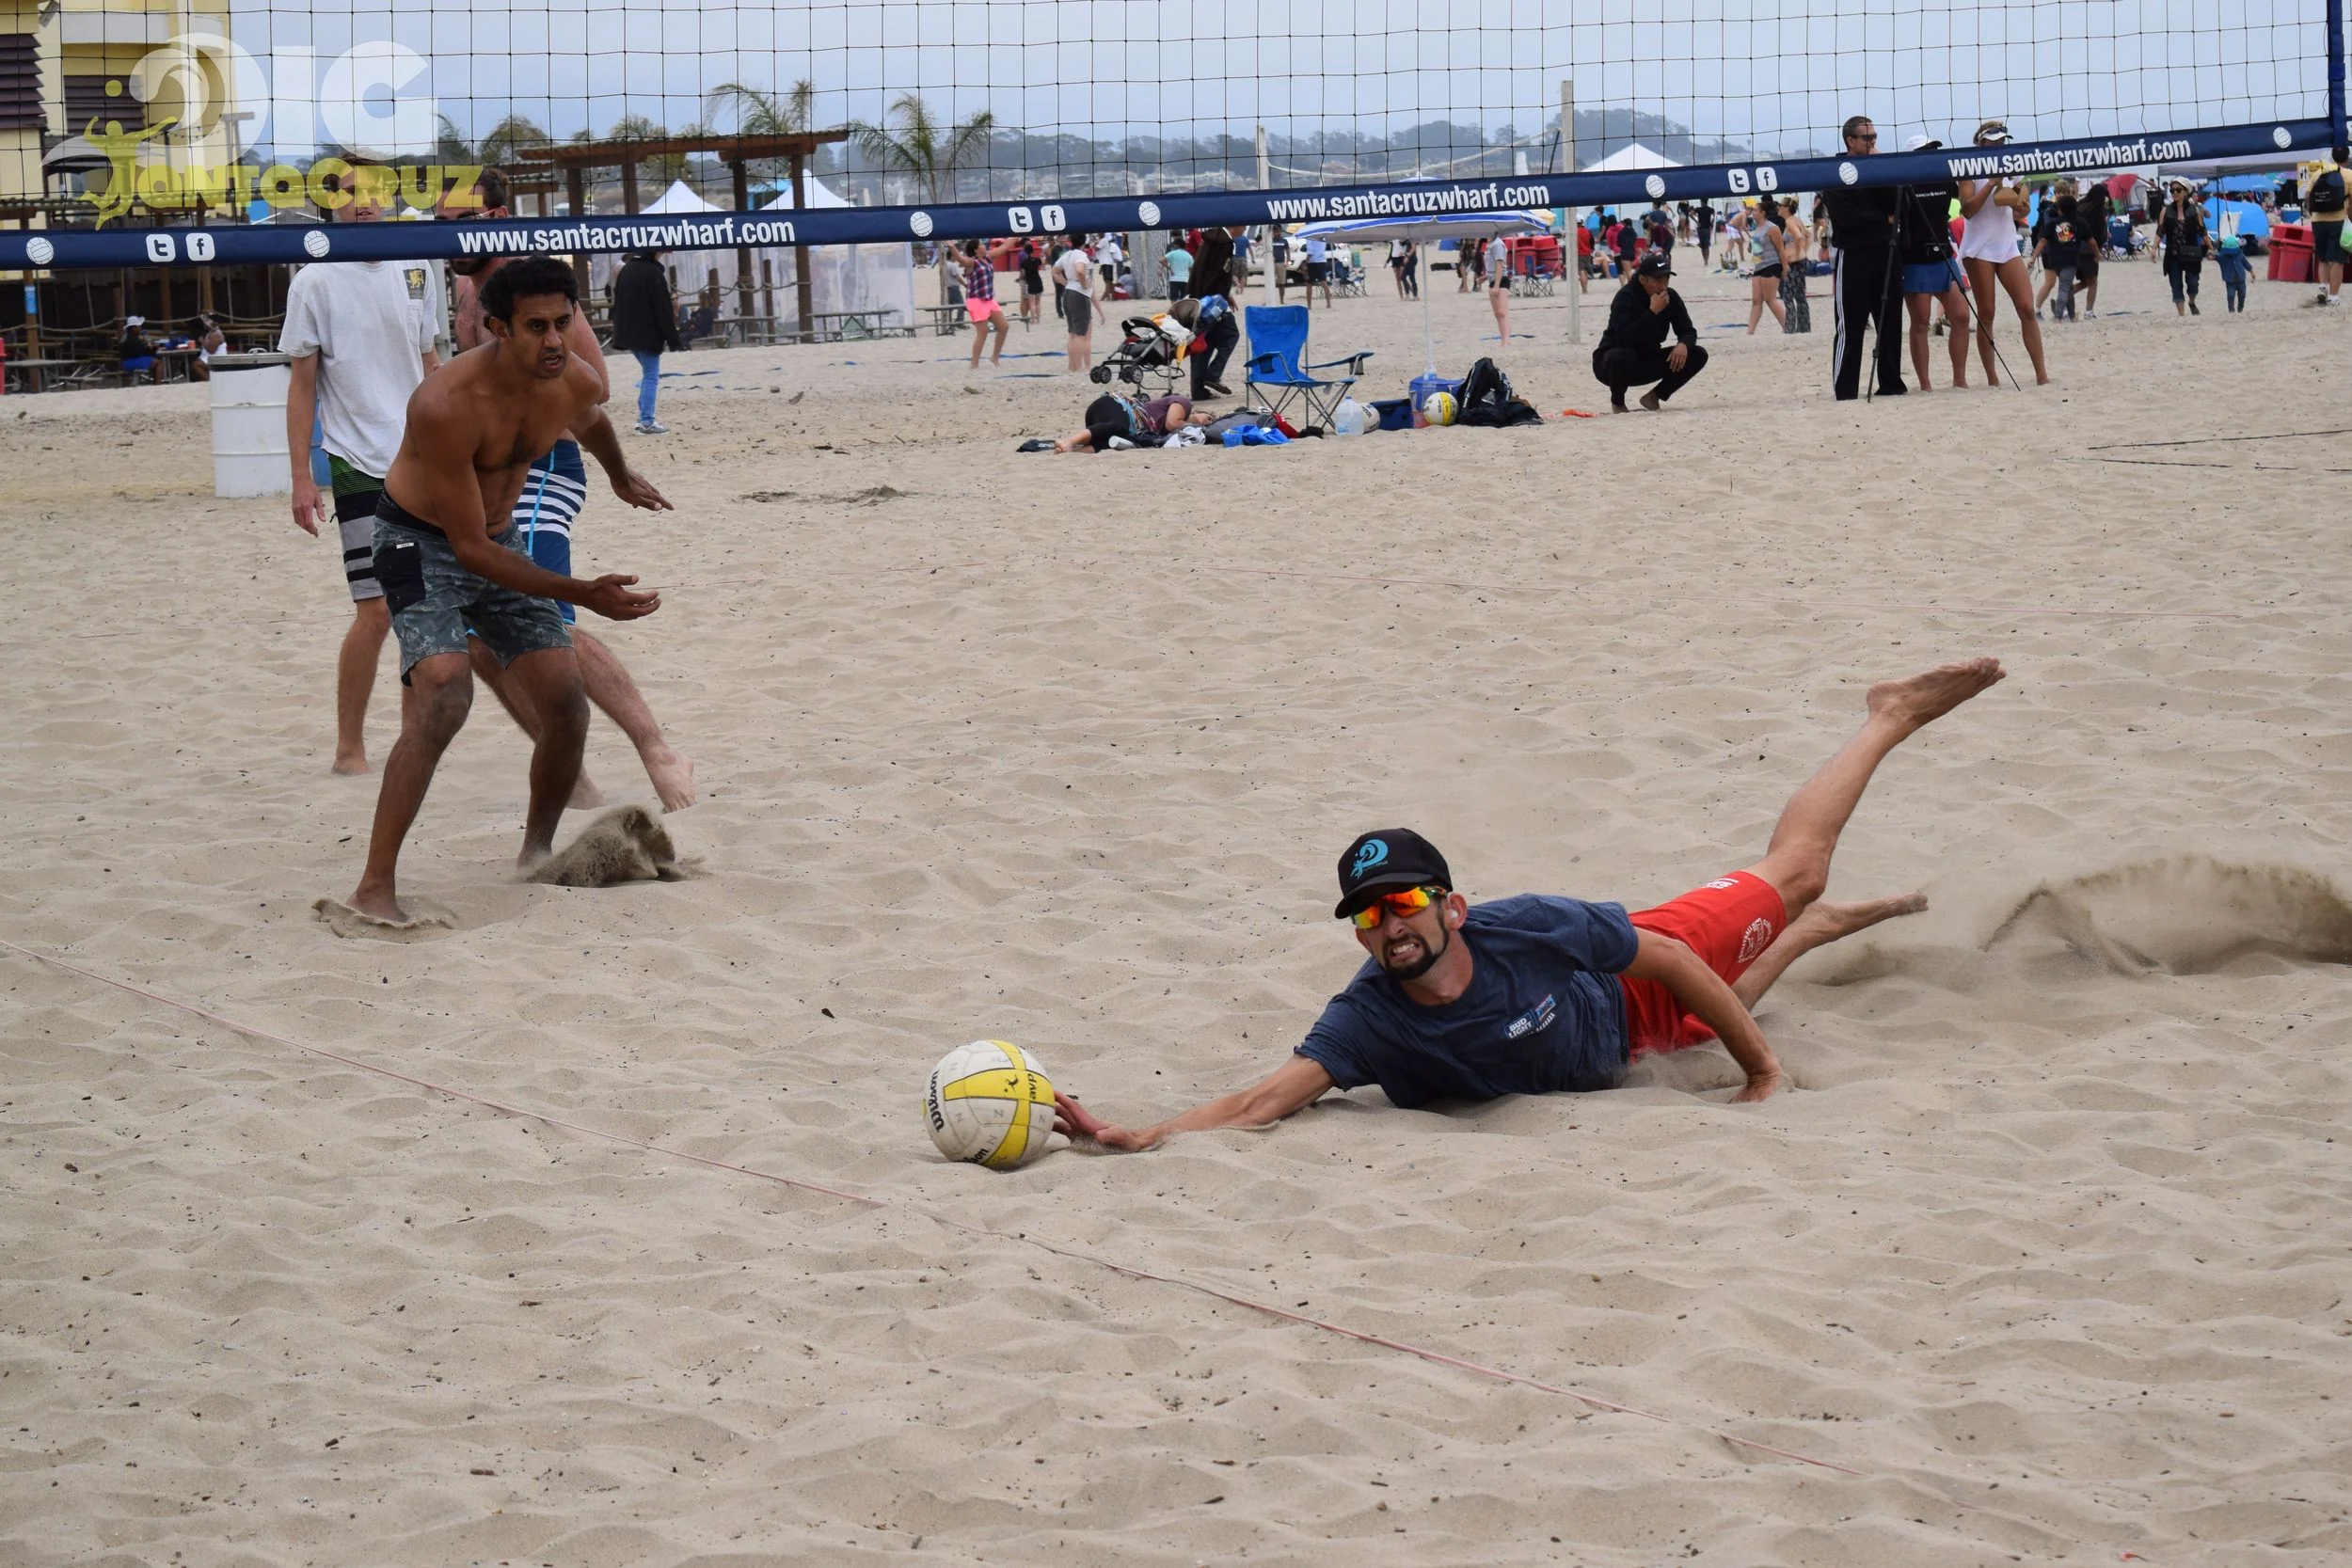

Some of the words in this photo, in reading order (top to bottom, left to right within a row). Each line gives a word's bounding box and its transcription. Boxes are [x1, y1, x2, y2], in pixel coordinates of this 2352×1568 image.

[1948, 139, 2191, 177] www.santacruzwharf.com
[1267, 182, 1549, 220] www.santacruzwharf.com
[457, 217, 795, 254] www.santacruzwharf.com
[1508, 1021, 1532, 1038] LIGHT
[1509, 1018, 1527, 1032] BUD
[1027, 1073, 1037, 1101] avp
